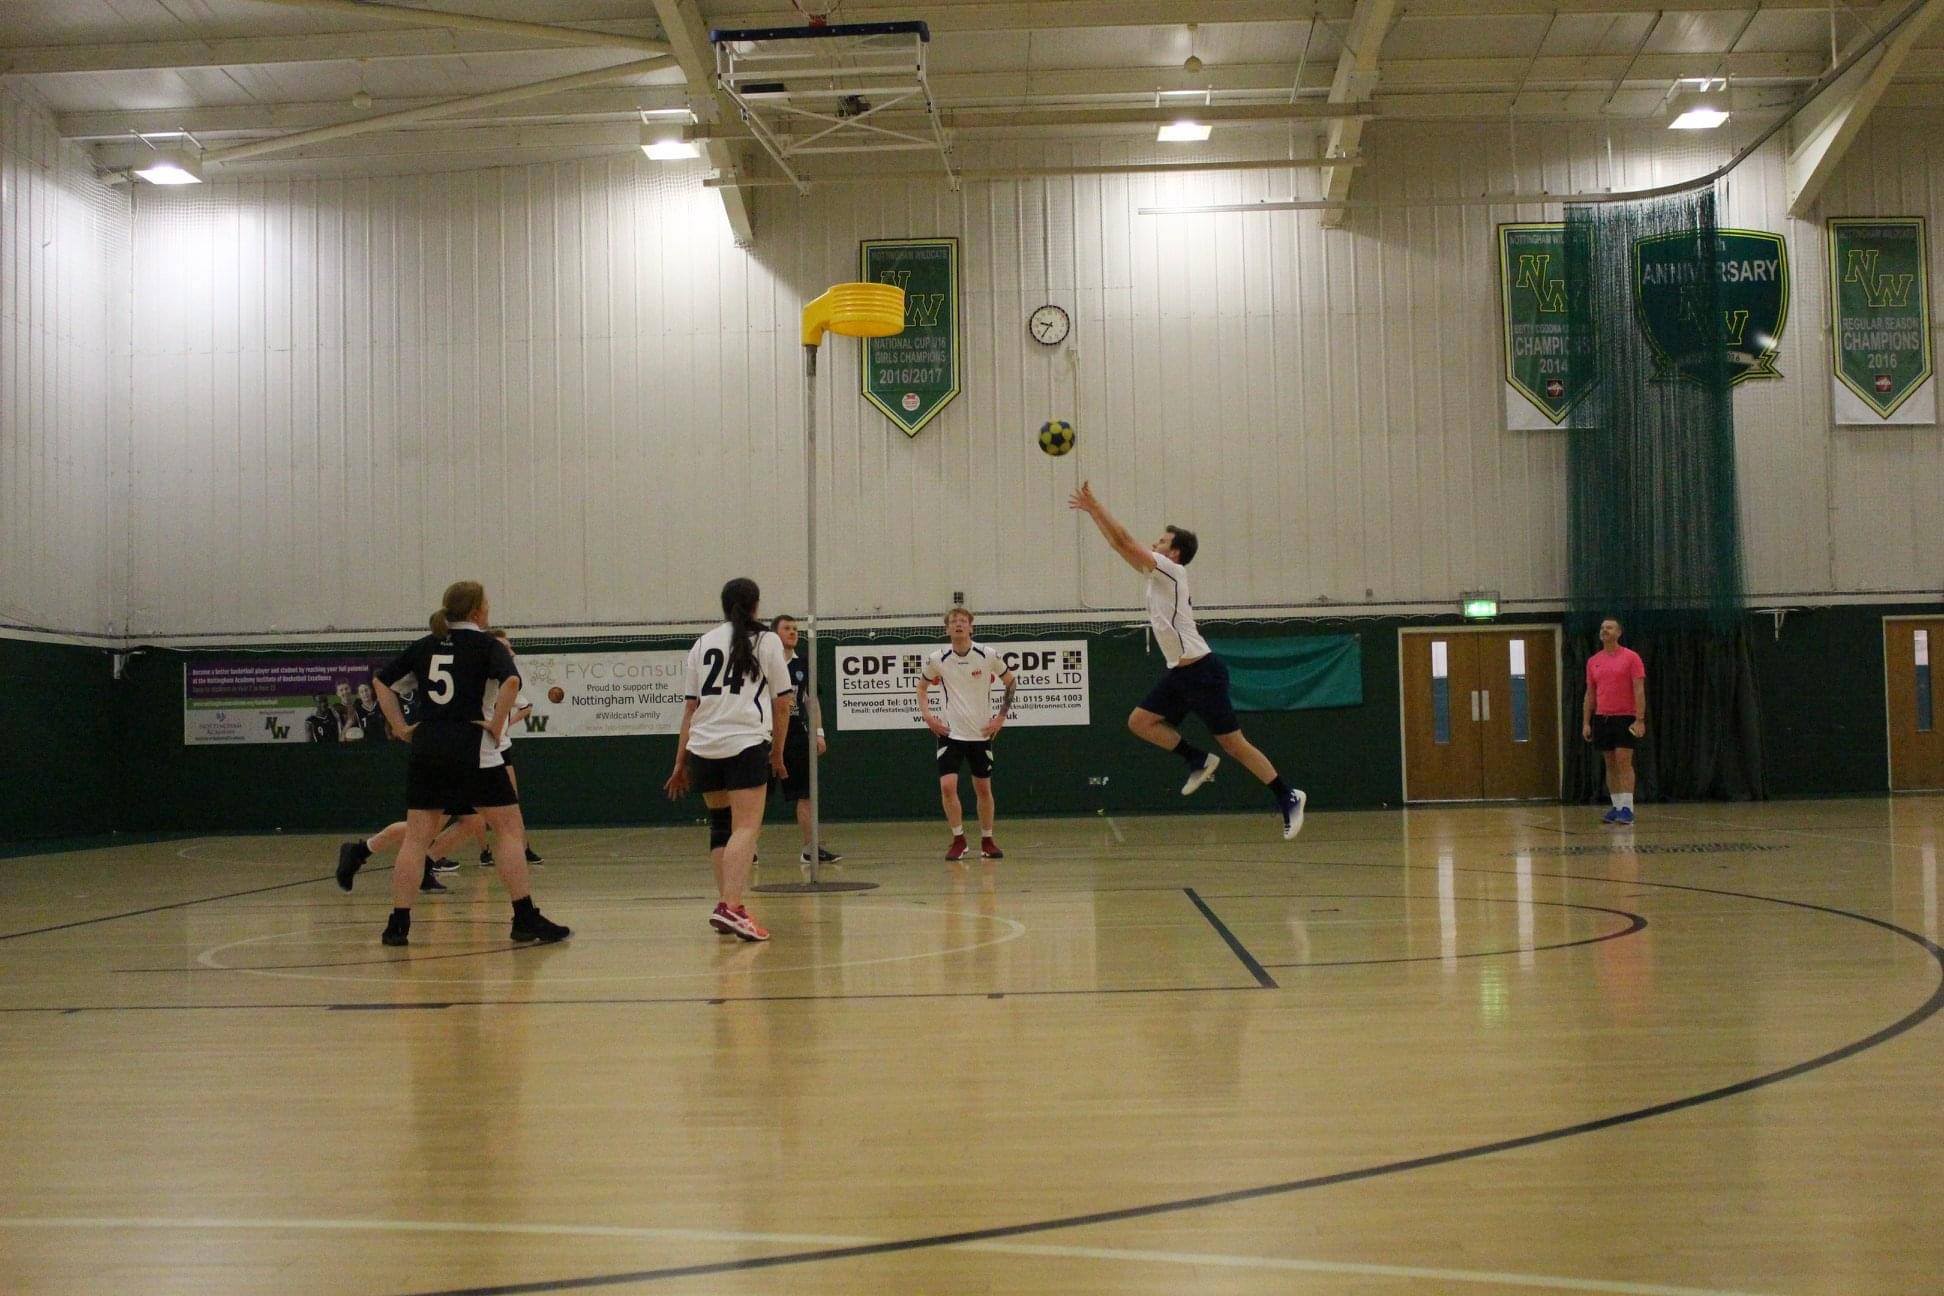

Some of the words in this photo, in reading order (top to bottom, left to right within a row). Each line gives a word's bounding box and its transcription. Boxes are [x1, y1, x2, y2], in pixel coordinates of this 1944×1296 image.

[1642, 259, 1779, 285] ANNIVRSARY
[1844, 331, 1920, 350] CHAMPIONS
[875, 352, 898, 363] GIRLS
[900, 351, 946, 363] CHAMPIONS
[1867, 353, 1898, 369] 2016
[1540, 358, 1568, 373] 2014
[880, 368, 943, 384] 2016/2017
[842, 655, 897, 675] CDF
[1002, 651, 1057, 671] CDF
[566, 662, 604, 679] FYC
[612, 660, 684, 678] Consul
[701, 648, 745, 696] 24
[427, 654, 455, 705] 5
[843, 678, 890, 690] Estates
[1017, 674, 1050, 685] tates
[1056, 672, 1082, 684] LTD
[586, 683, 610, 692] Proud
[612, 683, 621, 691] to
[622, 683, 653, 693] support
[655, 682, 668, 690] the
[572, 694, 634, 708] Nottingham
[638, 693, 684, 704] Wildcats
[842, 698, 885, 707] Sherwood
[1023, 695, 1043, 703] 0115
[1045, 694, 1061, 702] 964
[596, 711, 662, 720] #WildcatsFamily
